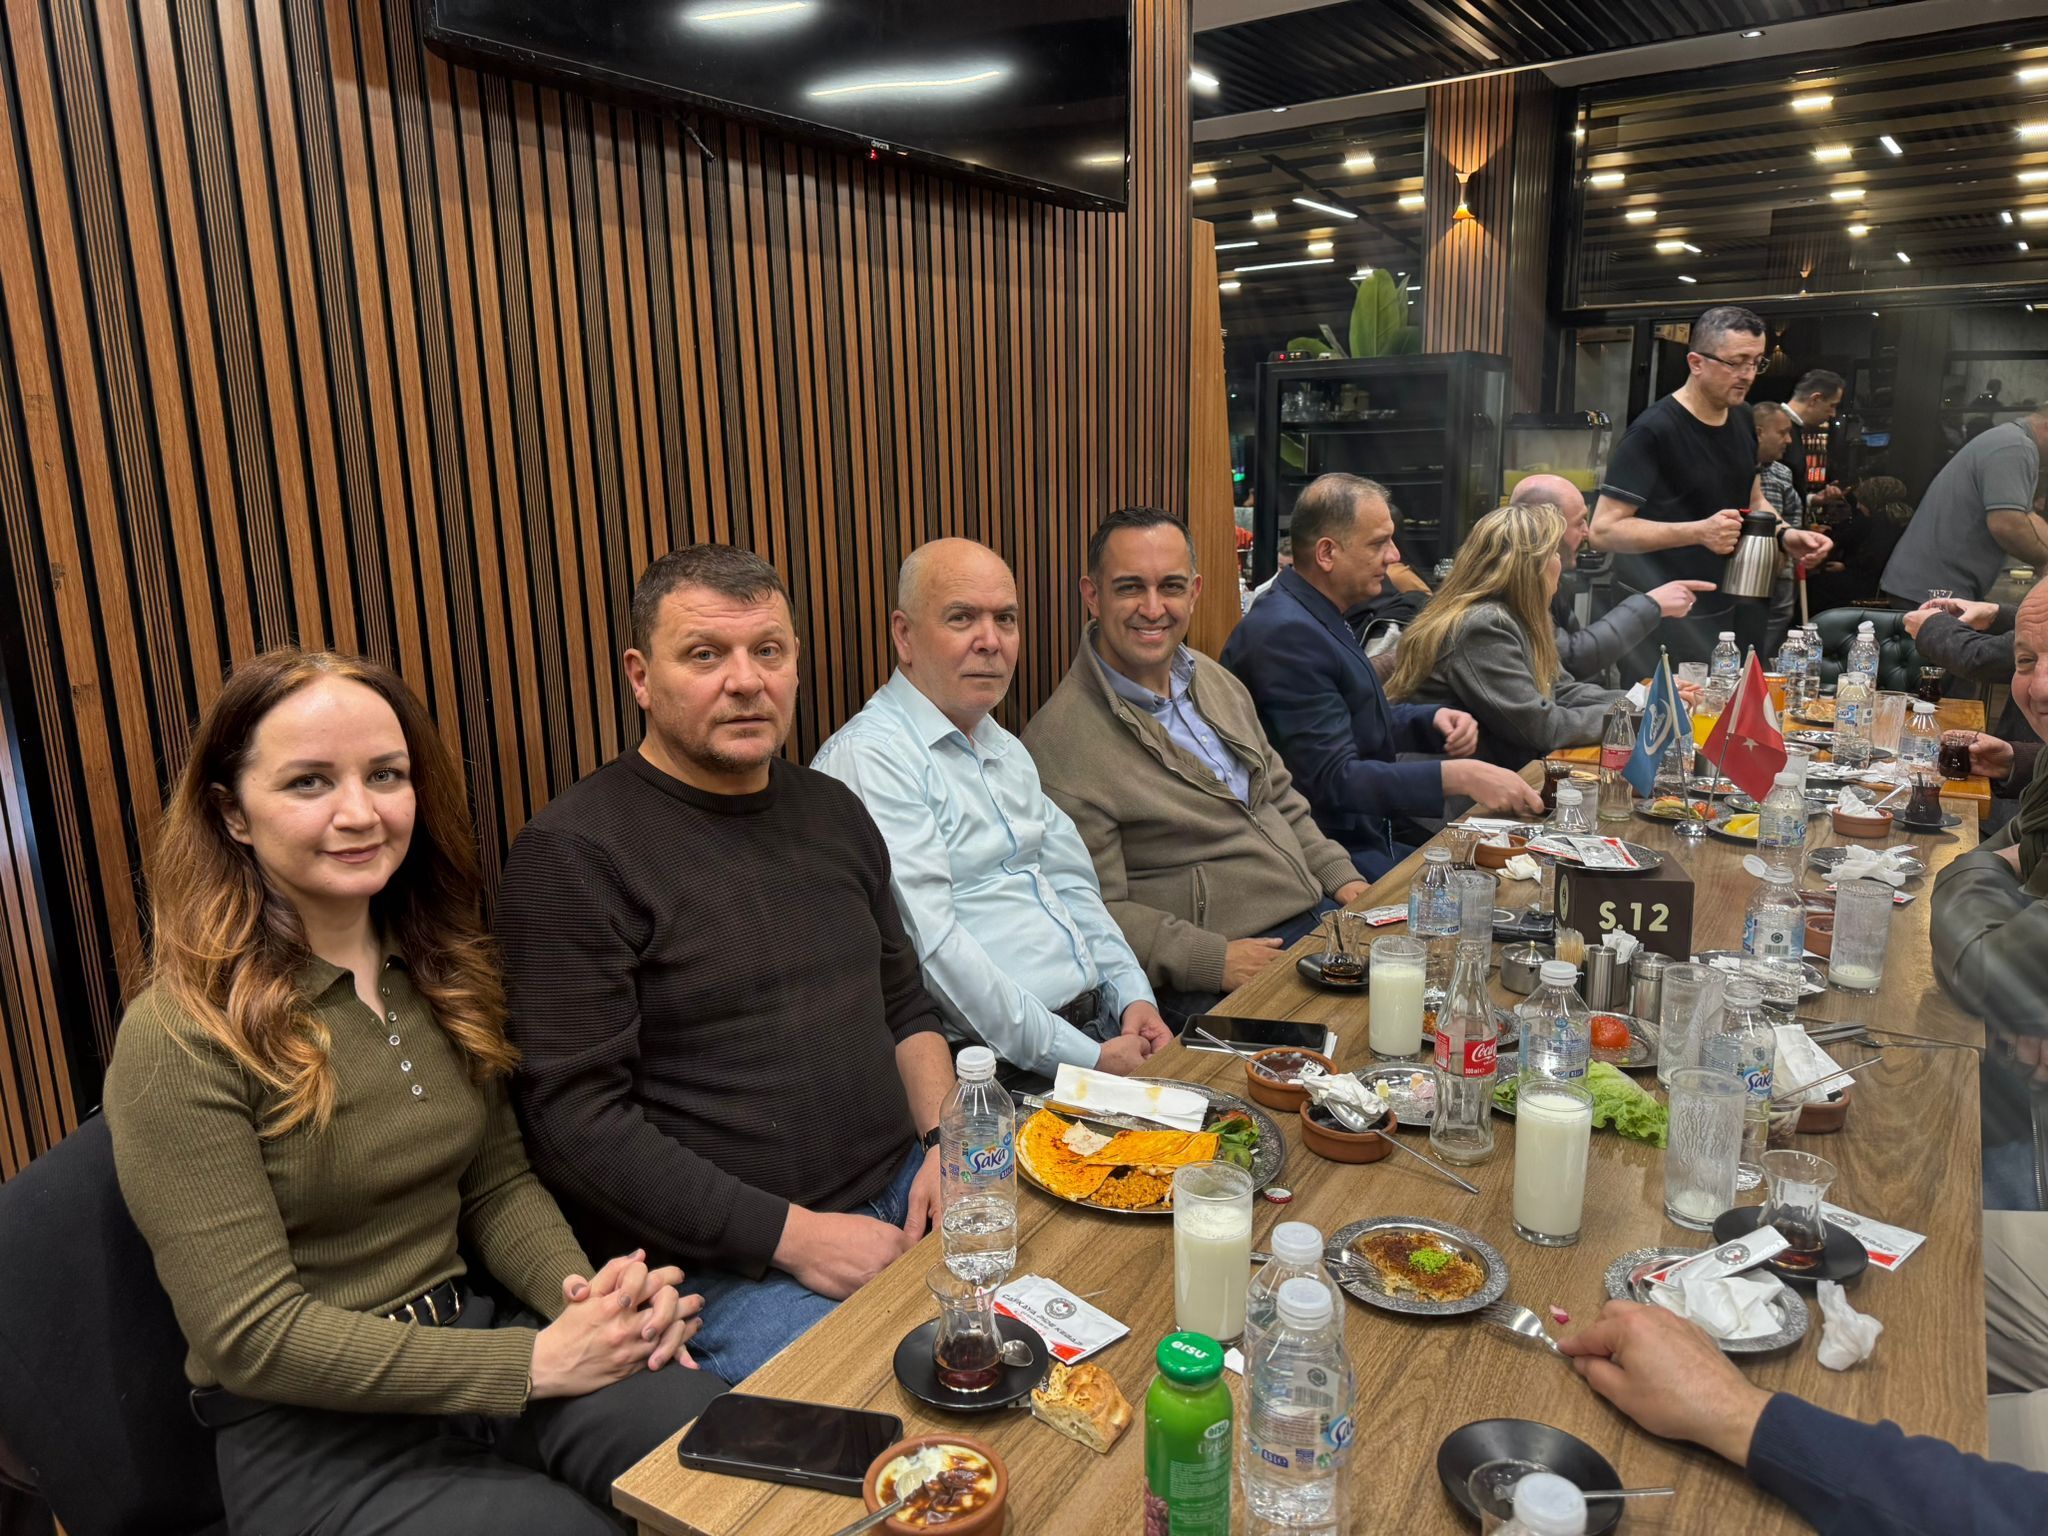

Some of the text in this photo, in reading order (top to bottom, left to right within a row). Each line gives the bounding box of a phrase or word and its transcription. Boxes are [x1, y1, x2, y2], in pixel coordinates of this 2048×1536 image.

[1599, 901, 1669, 932] S.12
[972, 1148, 1006, 1174] Saka
[1171, 1341, 1209, 1359] ersu
